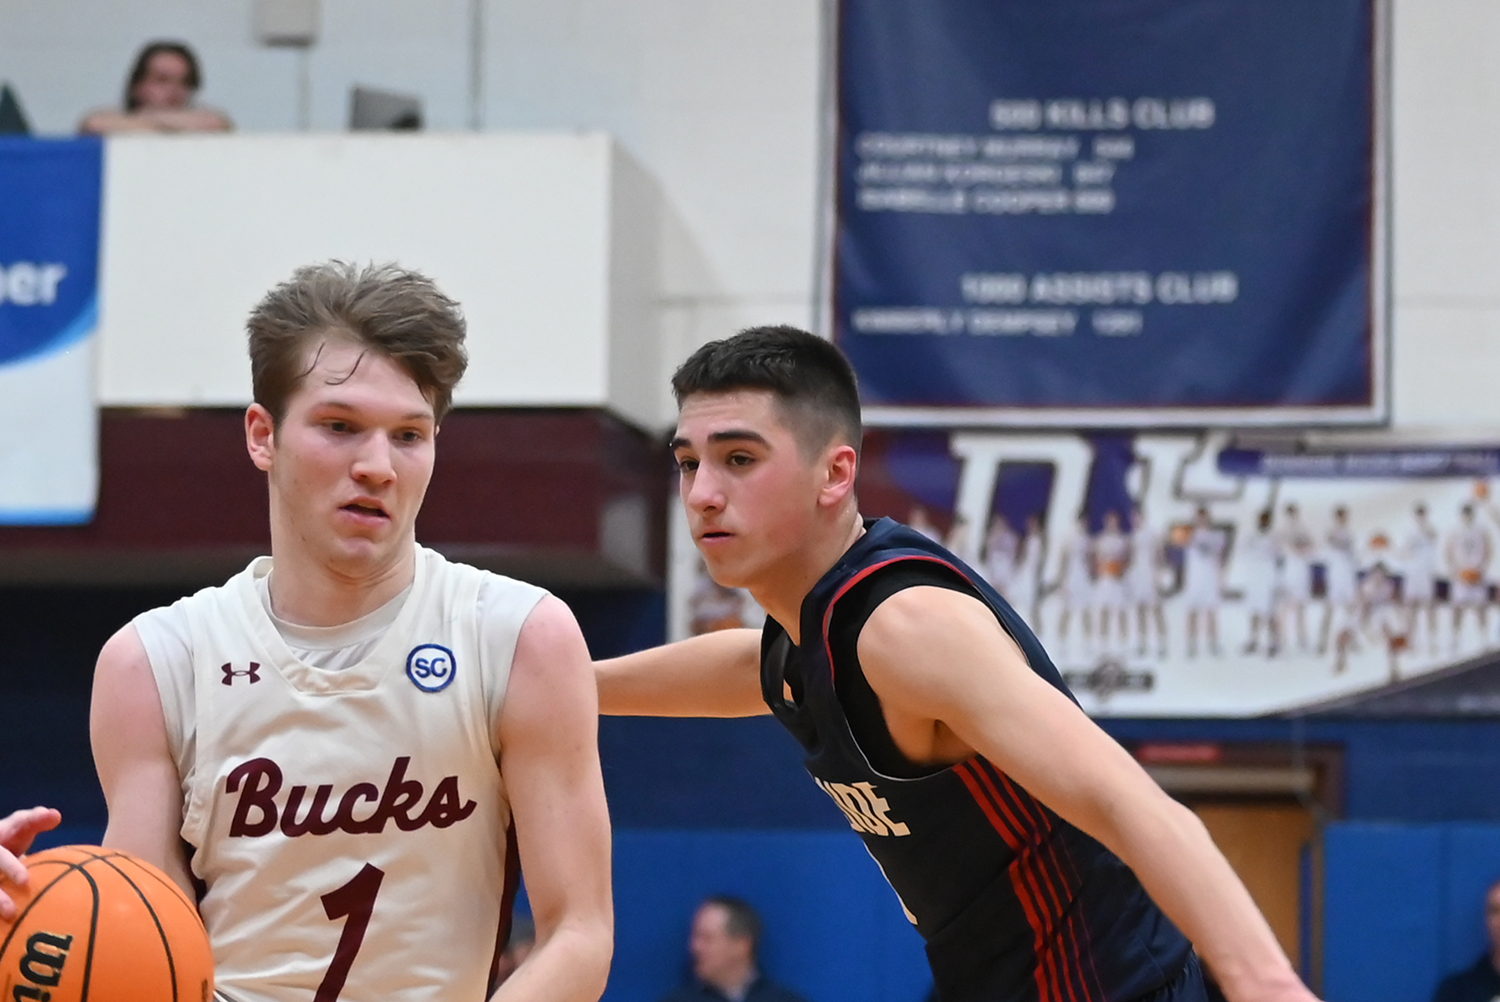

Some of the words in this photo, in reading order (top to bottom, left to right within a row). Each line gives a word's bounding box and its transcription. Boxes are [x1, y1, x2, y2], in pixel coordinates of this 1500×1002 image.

[1047, 100, 1128, 128] KILLS
[1135, 99, 1215, 127] CLUB
[1156, 271, 1237, 302] CLUB
[415, 657, 447, 678] SC
[225, 756, 477, 837] Bucks
